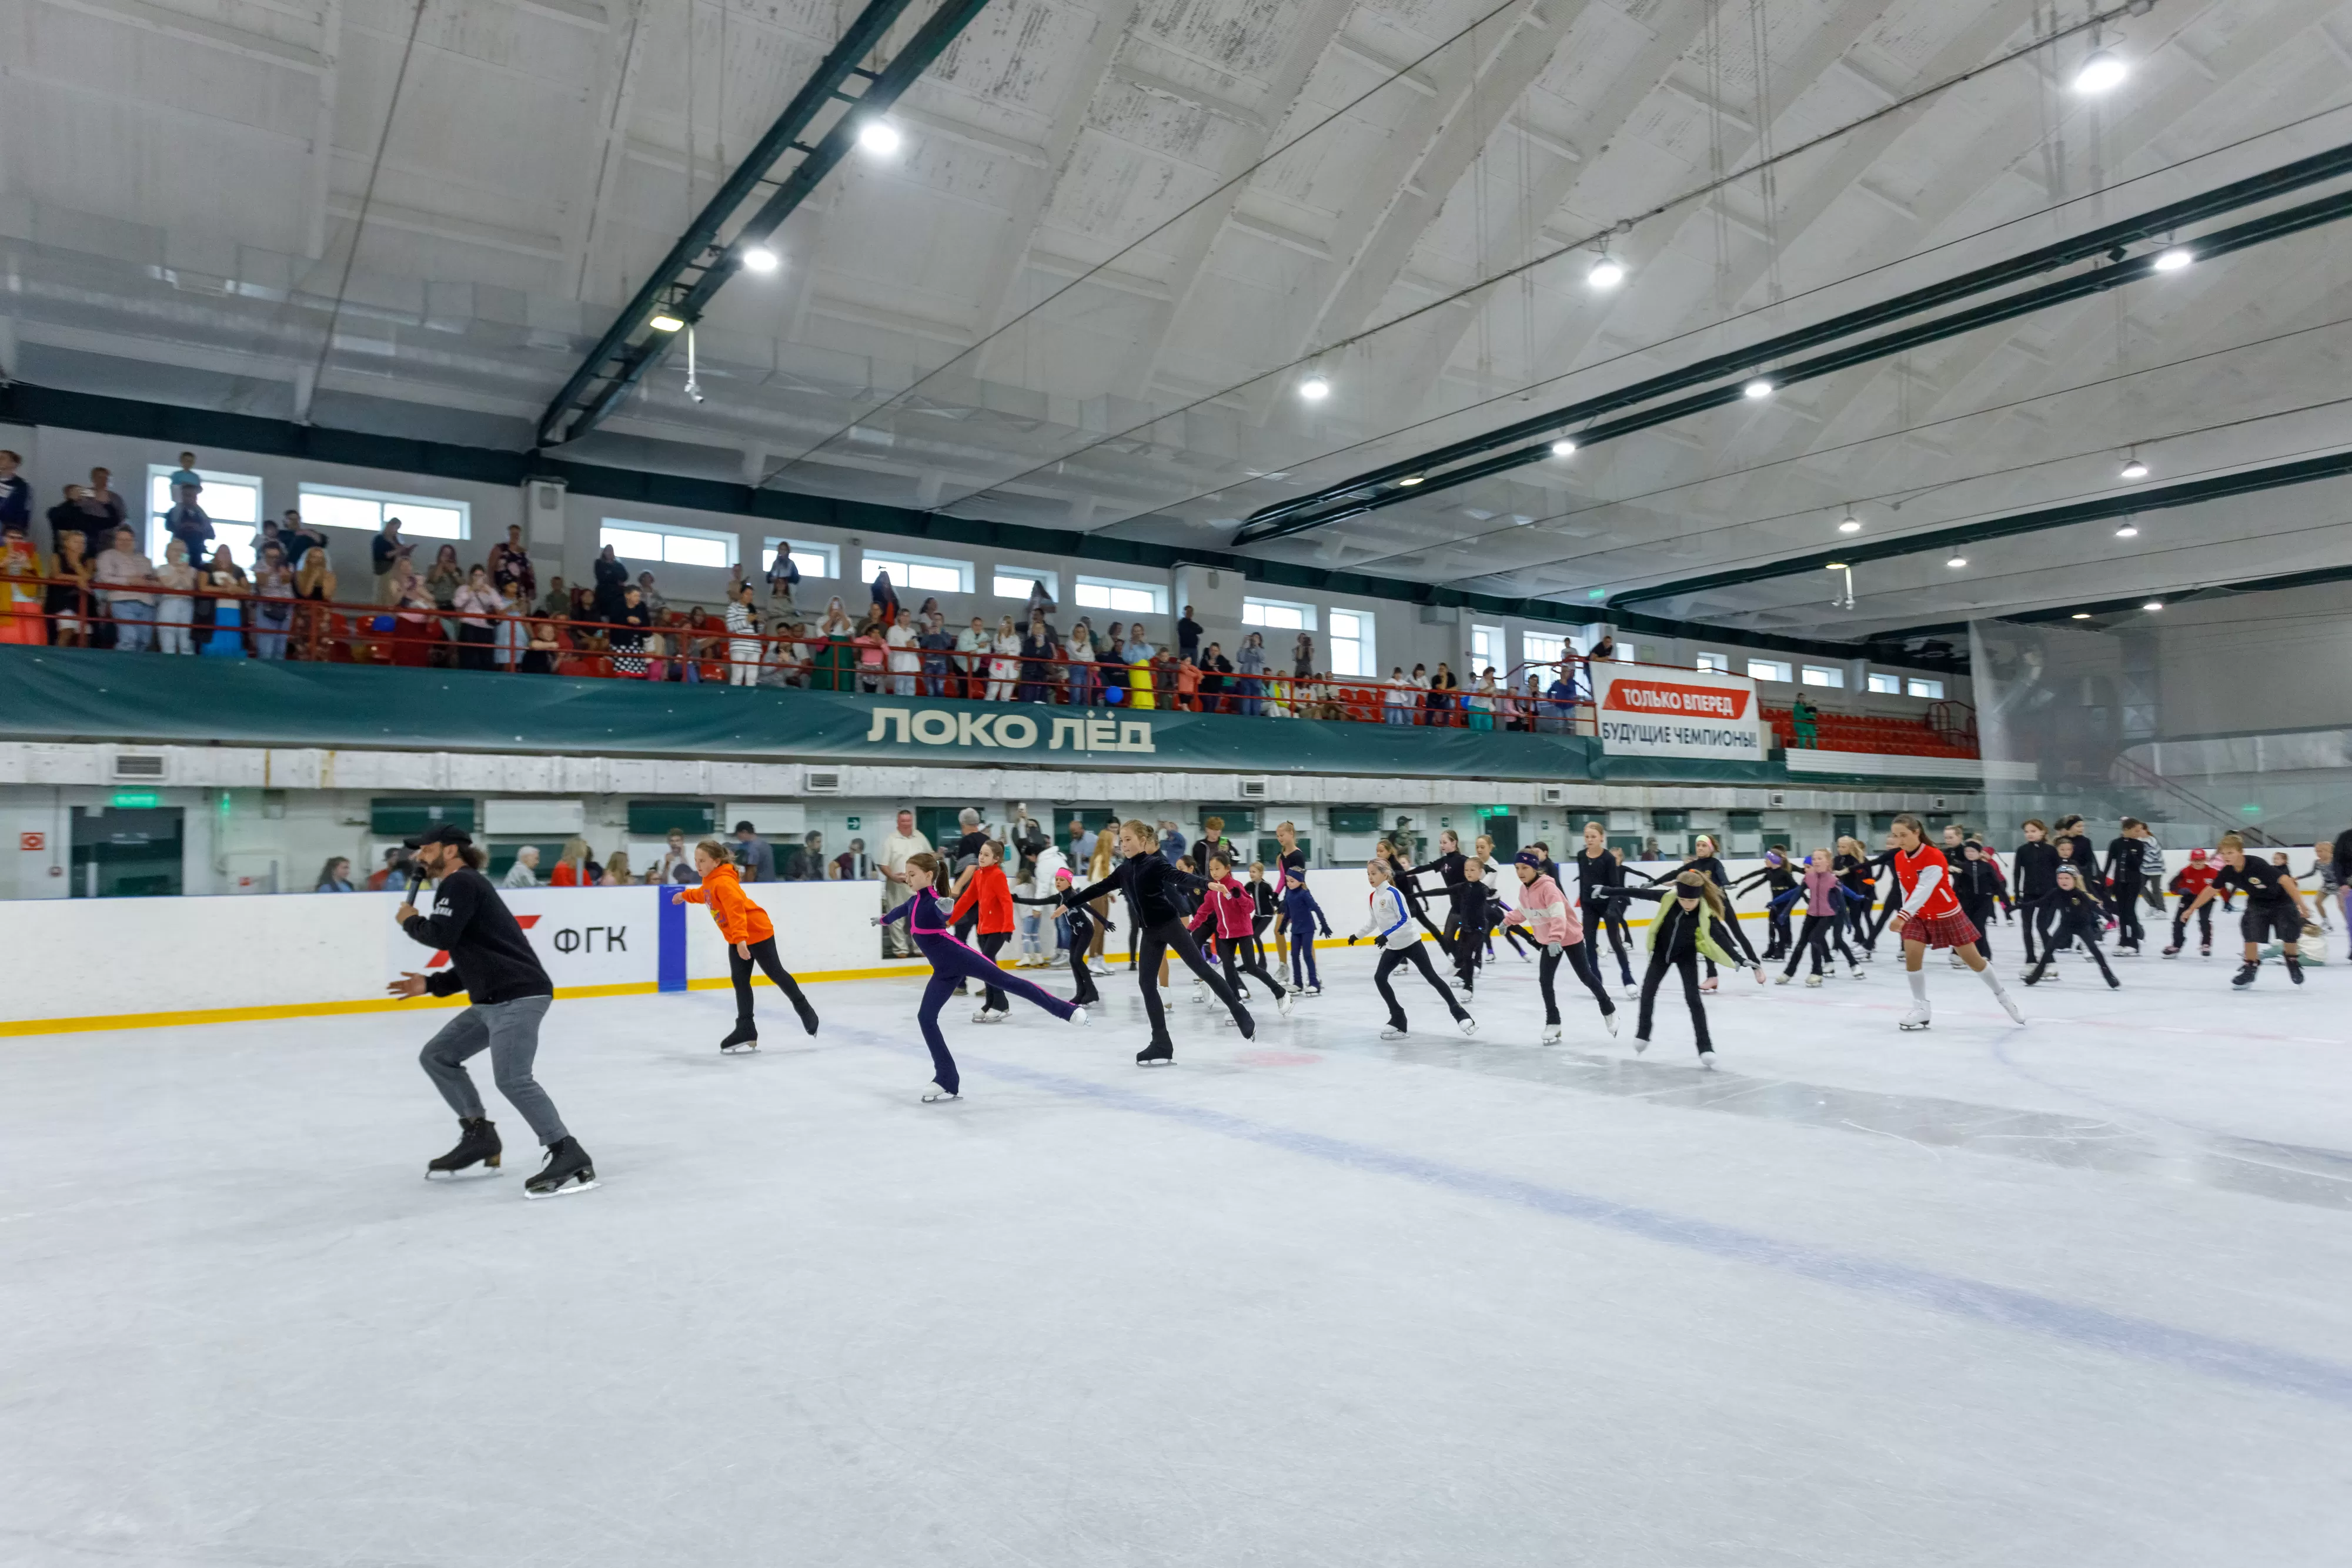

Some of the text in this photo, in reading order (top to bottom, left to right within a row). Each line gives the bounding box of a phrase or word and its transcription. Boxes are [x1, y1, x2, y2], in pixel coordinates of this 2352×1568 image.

[1622, 688, 1734, 716] ТОЛЬКО ВПЕРЕД
[867, 707, 1156, 753] ЛОКО ЛЁД
[1602, 722, 1671, 745] БУДУЩИЕ
[554, 925, 627, 954] ФГК
